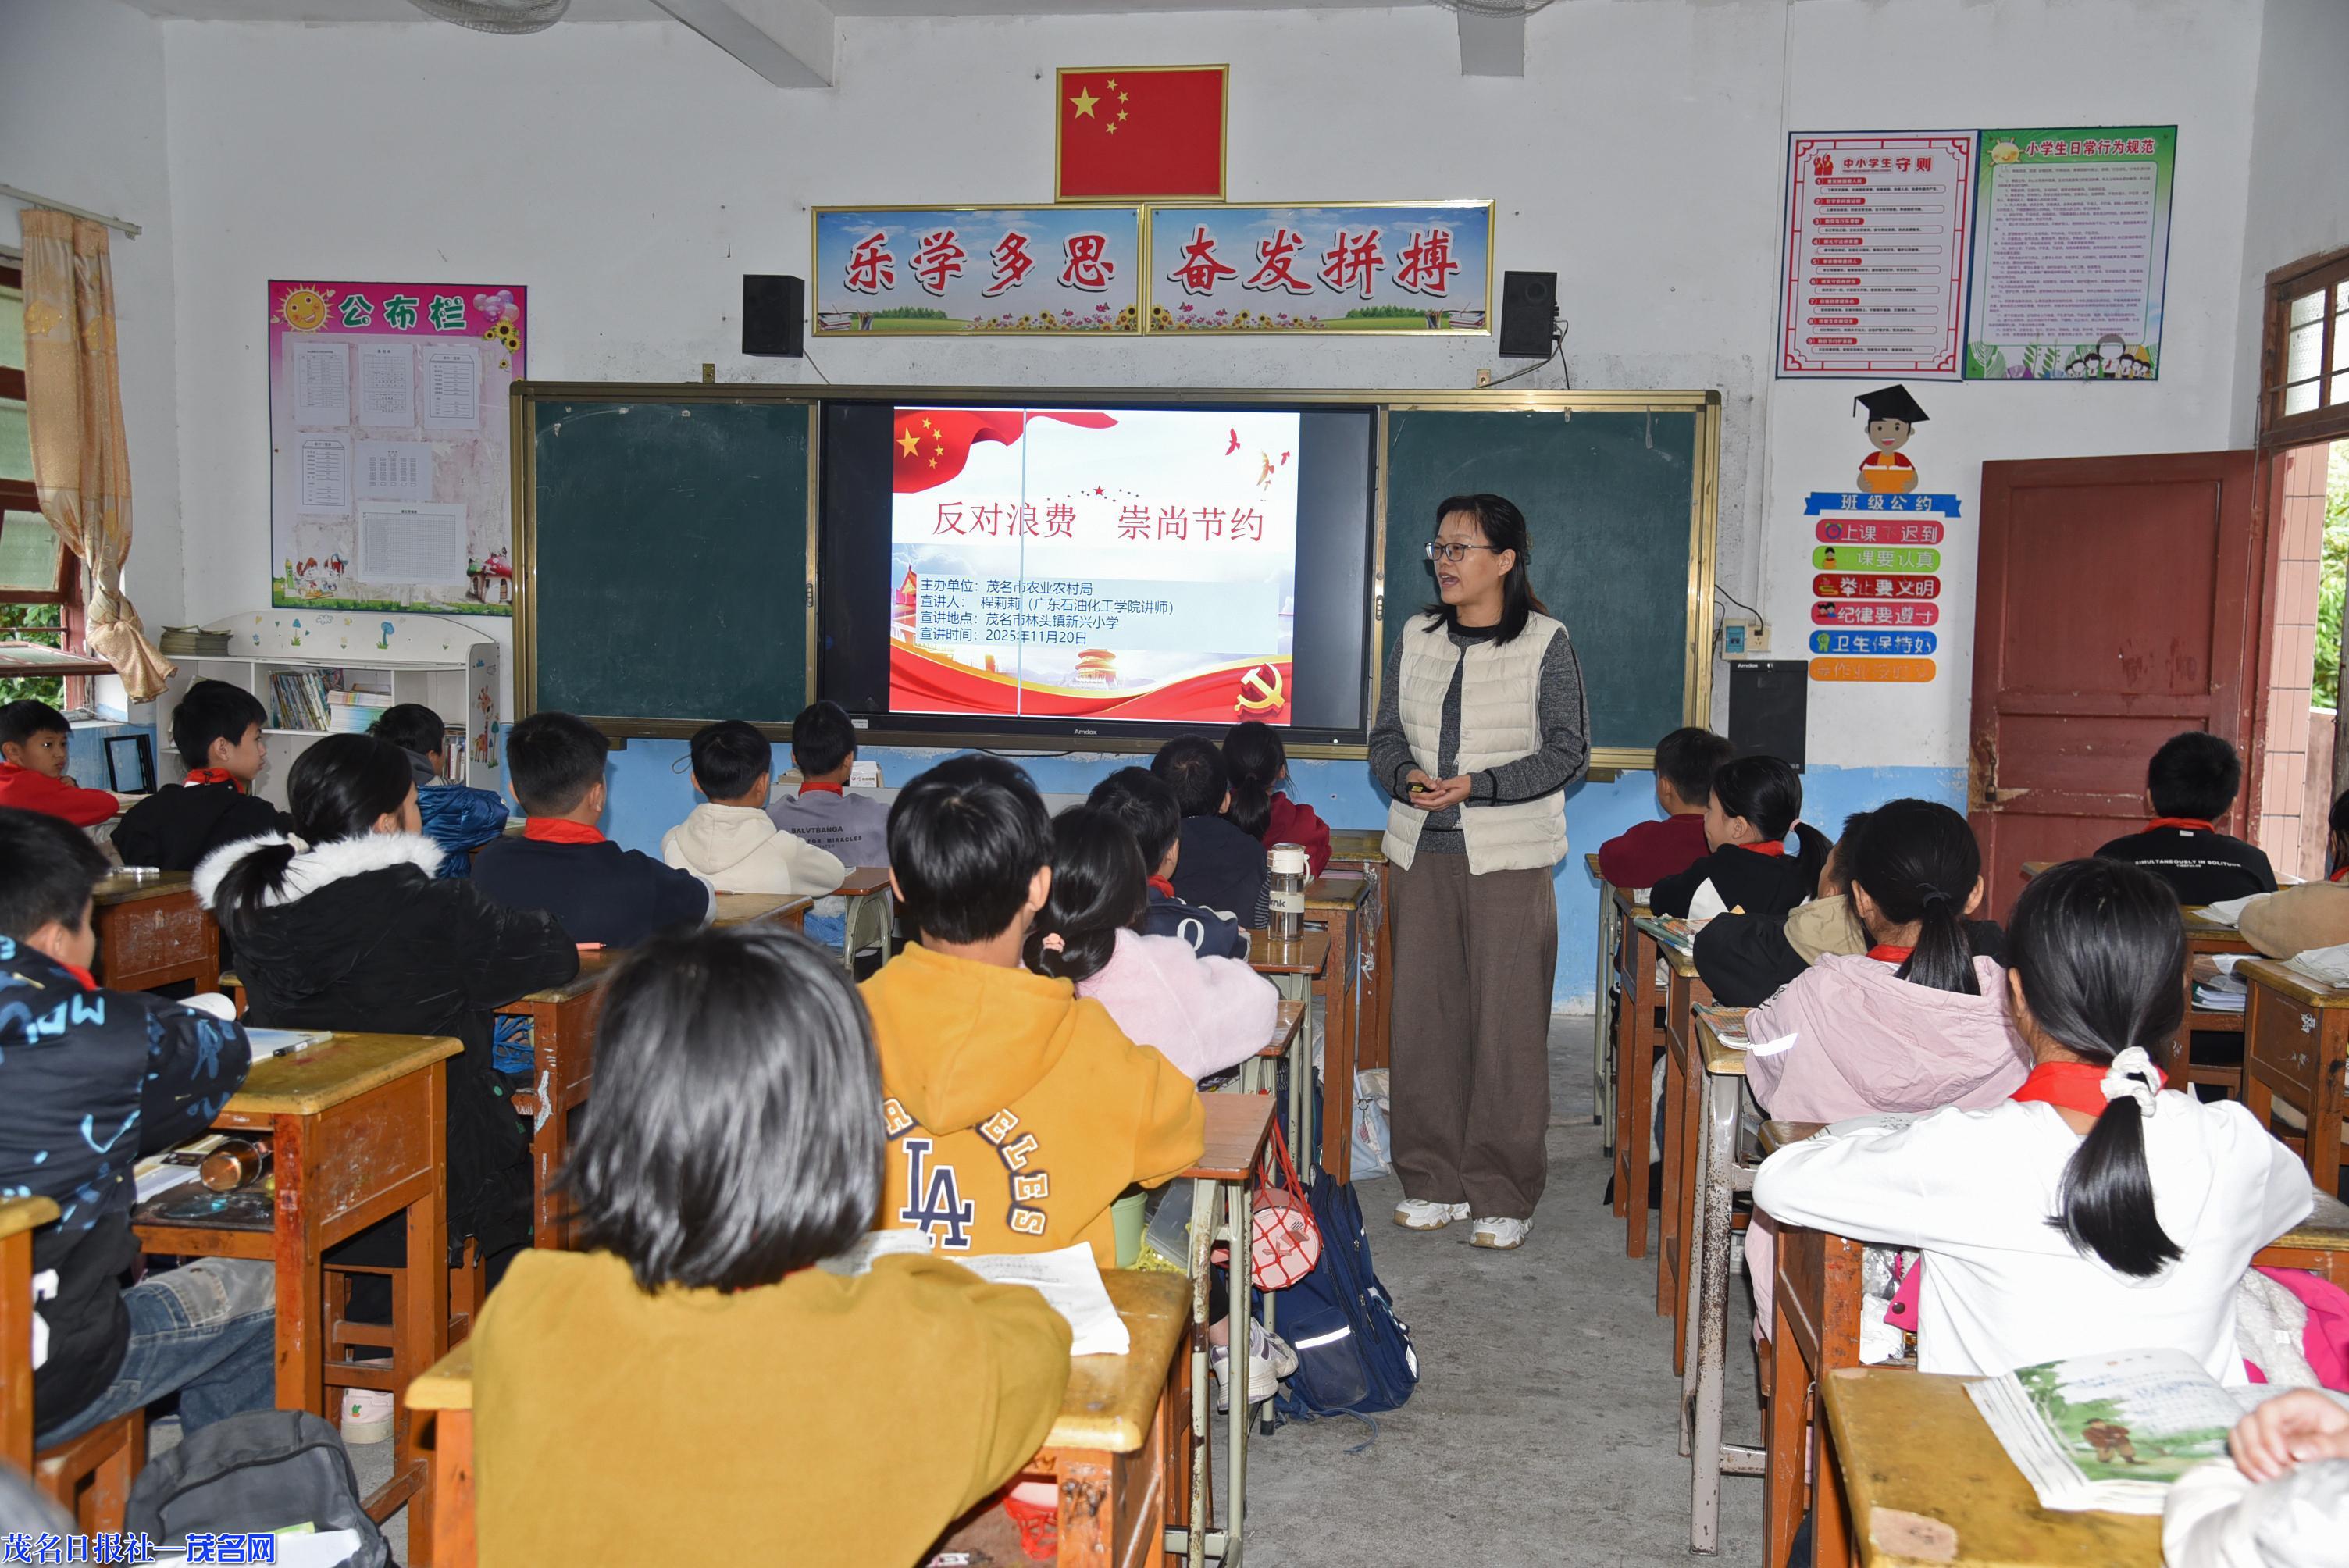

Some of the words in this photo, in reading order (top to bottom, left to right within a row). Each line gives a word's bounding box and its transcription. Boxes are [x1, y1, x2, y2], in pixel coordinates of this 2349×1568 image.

[2026, 138, 2155, 156] 小学生日常行为规范
[1843, 156, 1932, 173] 中小学生守则
[846, 230, 1115, 295] 乐学多思
[1171, 225, 1460, 297] 奋发拼搏
[339, 294, 468, 330] 公布栏
[1841, 494, 1933, 512] 班级公约
[932, 501, 1076, 539] 反对浪费
[1117, 504, 1264, 542] 崇尚节约
[826, 835, 862, 843] MIRACLES
